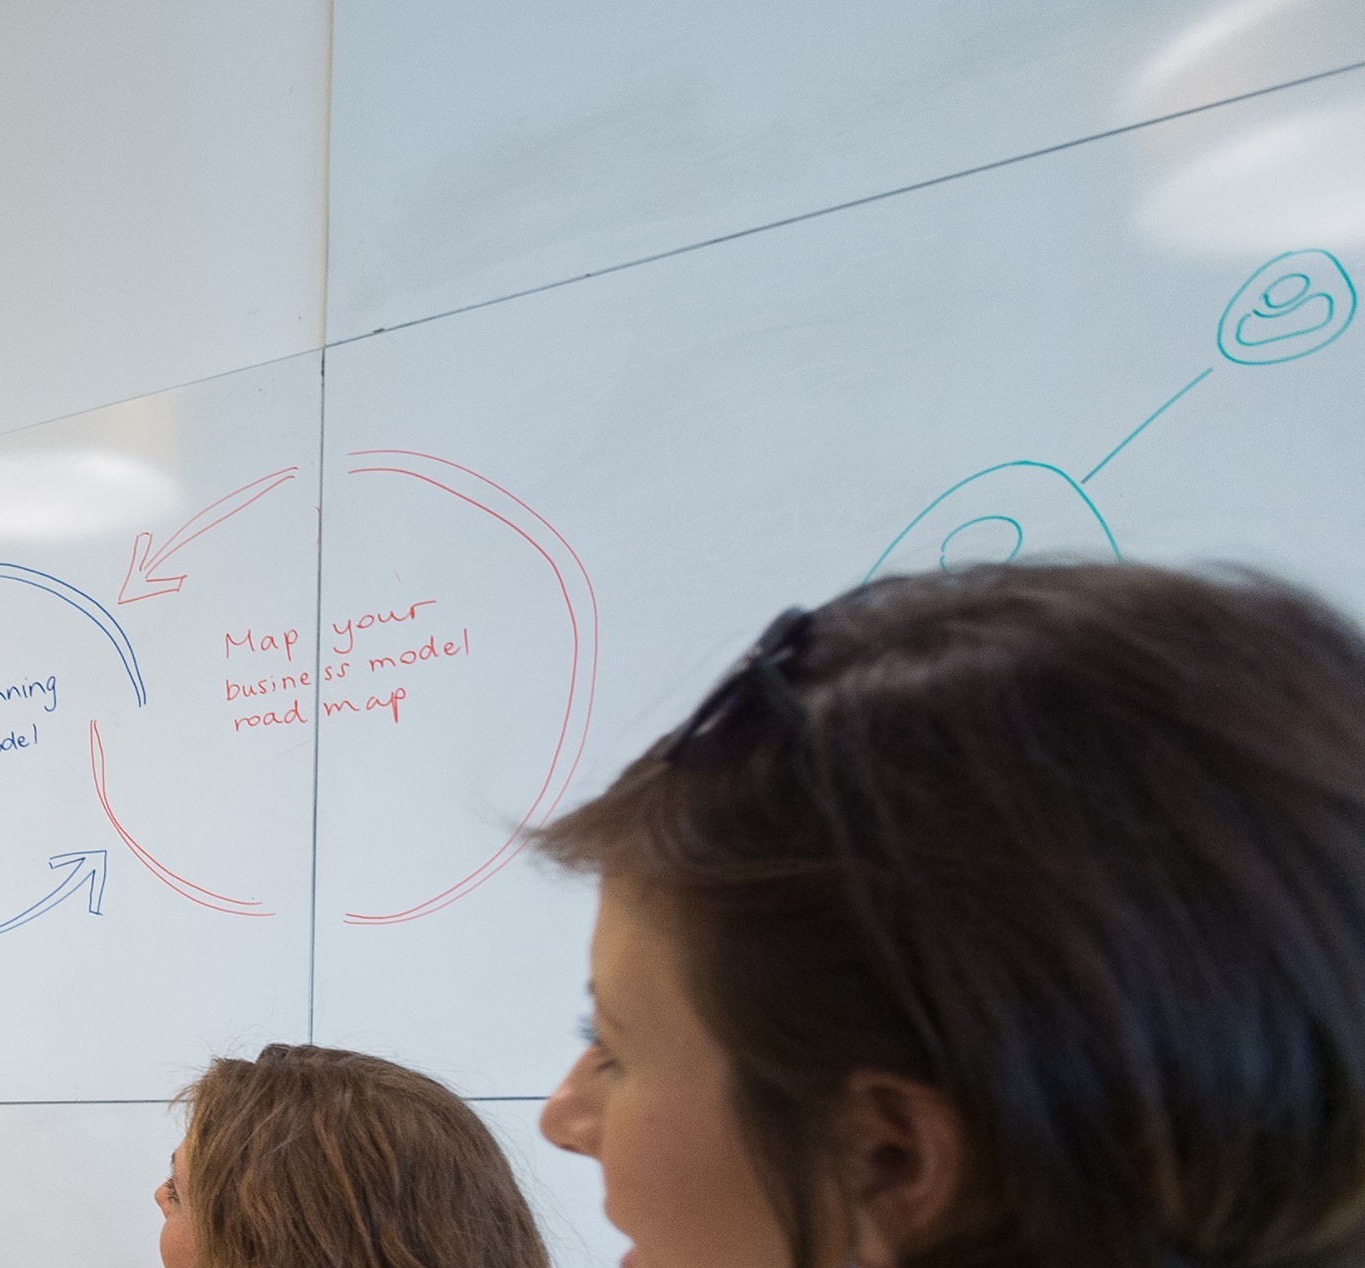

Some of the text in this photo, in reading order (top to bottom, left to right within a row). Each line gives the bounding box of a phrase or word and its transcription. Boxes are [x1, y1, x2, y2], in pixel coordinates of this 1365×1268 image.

[224, 599, 437, 662] Map your
[225, 627, 471, 702] business model
[233, 686, 407, 732] road map
